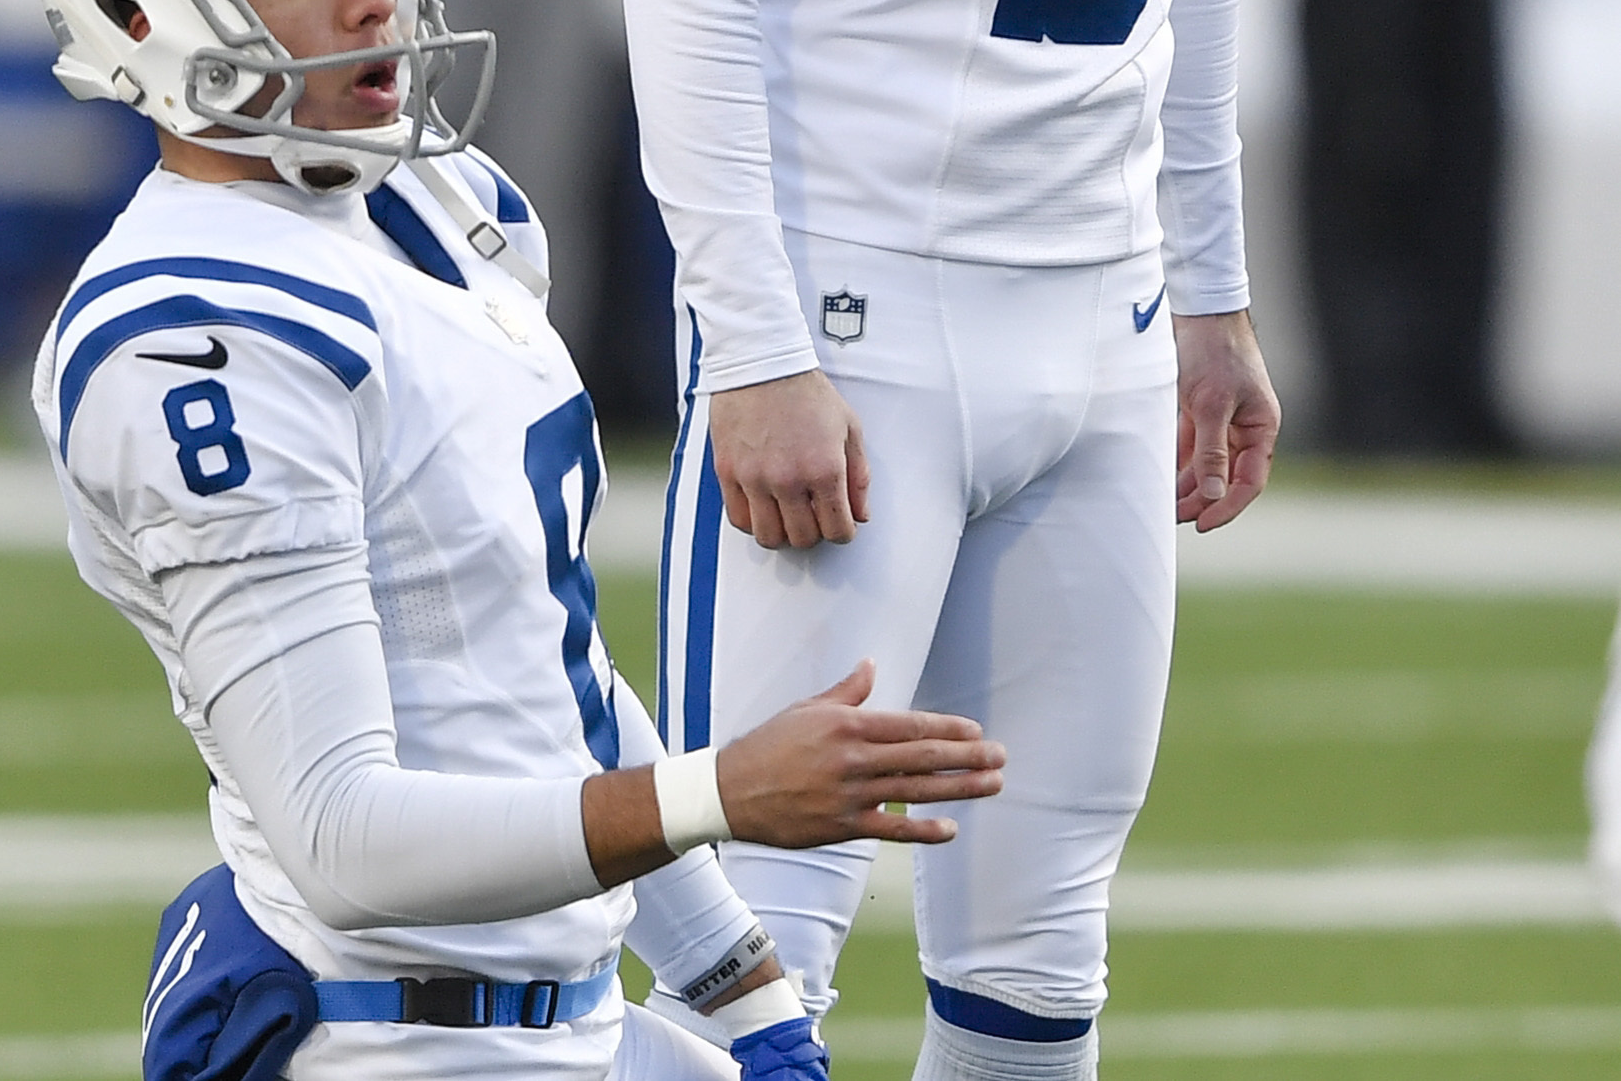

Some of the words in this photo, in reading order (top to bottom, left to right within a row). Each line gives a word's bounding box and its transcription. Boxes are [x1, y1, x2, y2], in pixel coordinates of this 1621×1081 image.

[161, 378, 252, 496] 8
[524, 389, 620, 771] 8
[685, 957, 741, 1001] BETTER
